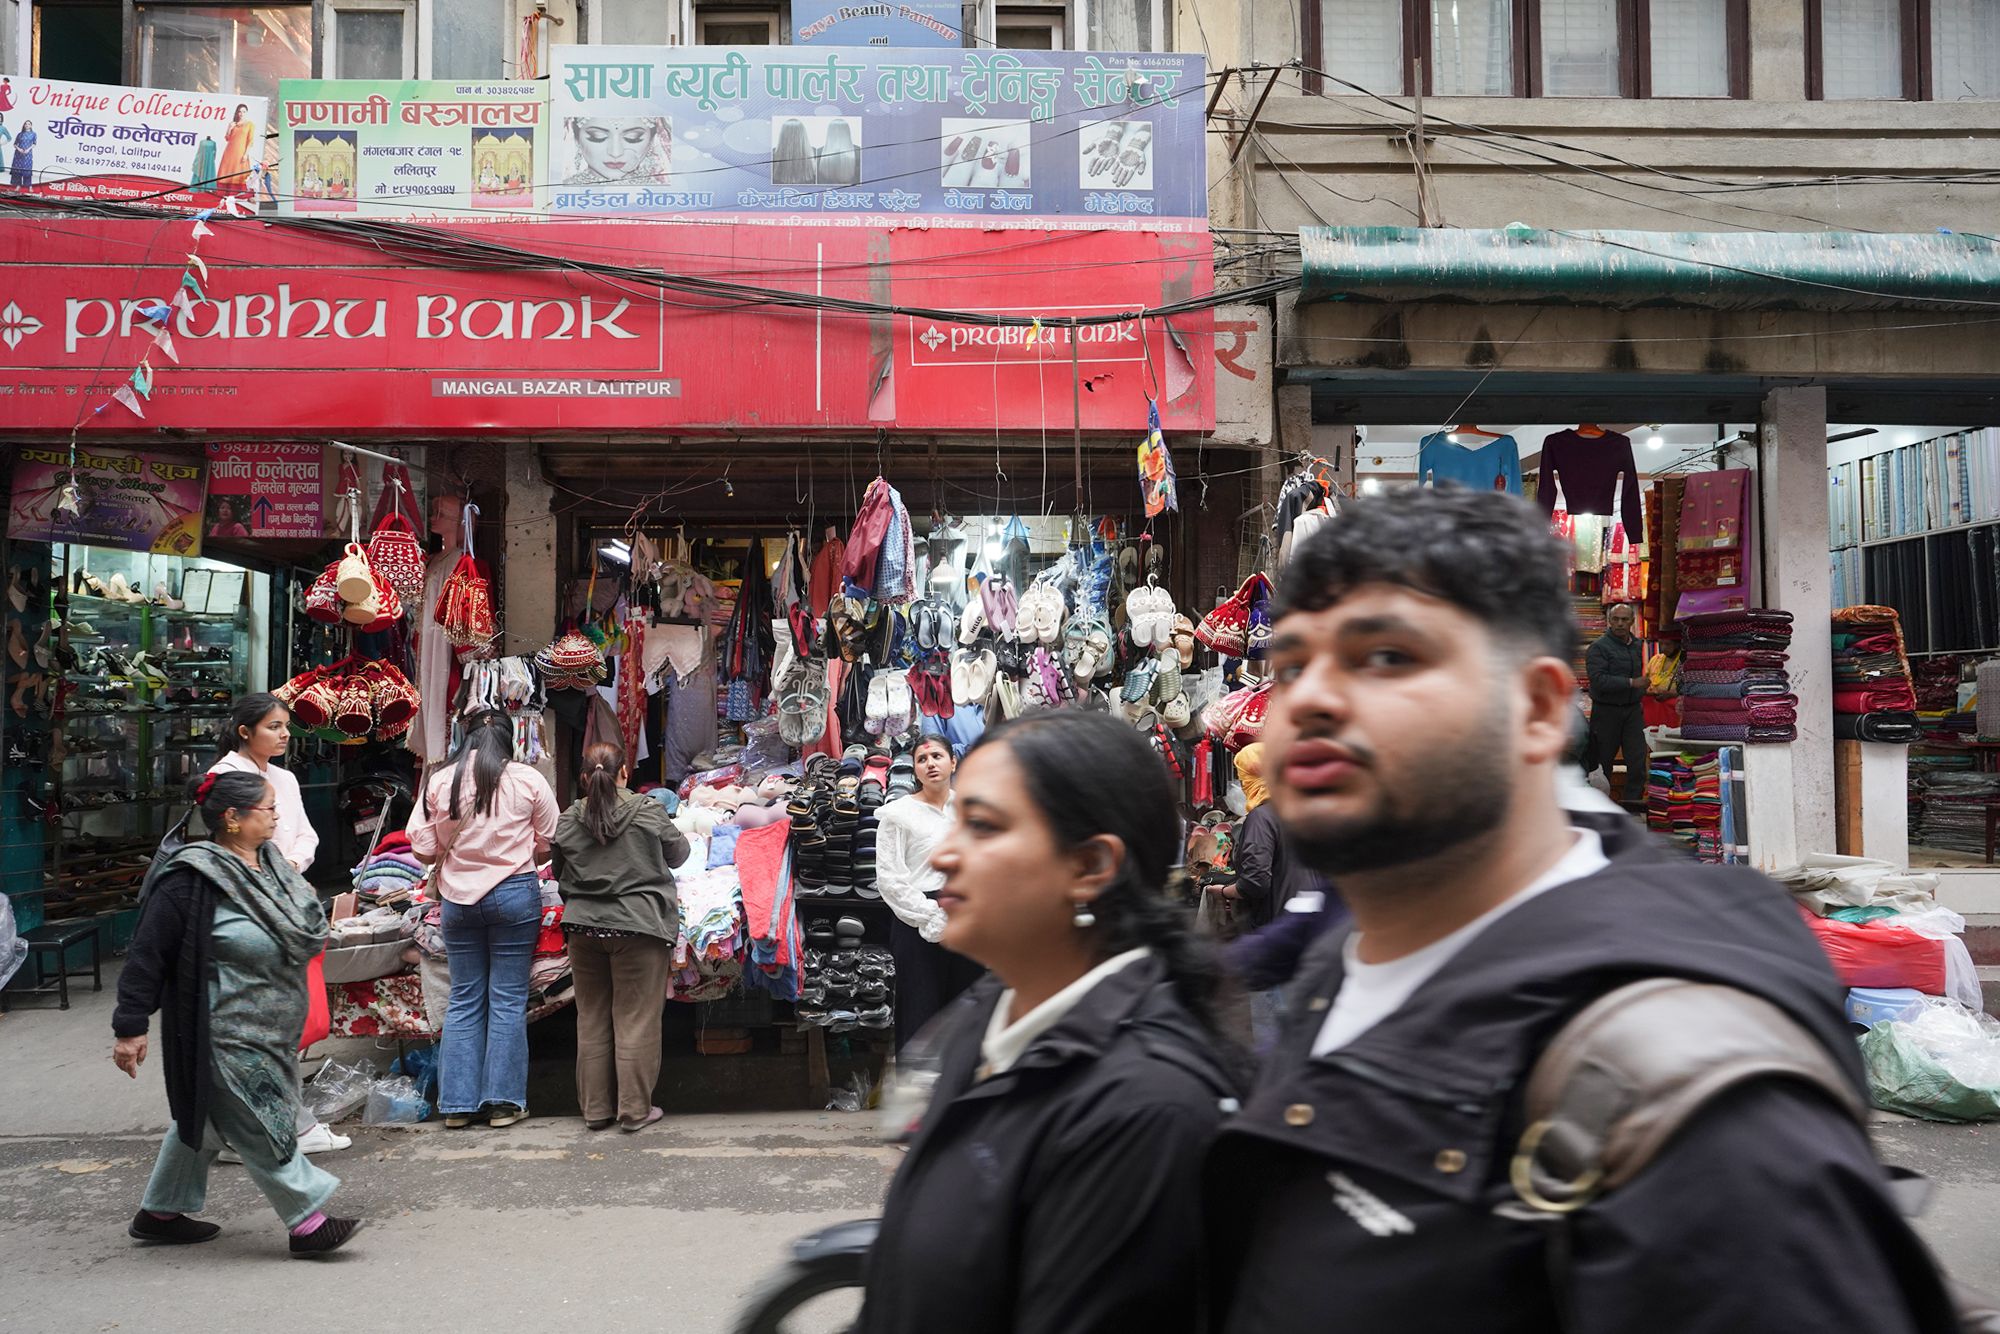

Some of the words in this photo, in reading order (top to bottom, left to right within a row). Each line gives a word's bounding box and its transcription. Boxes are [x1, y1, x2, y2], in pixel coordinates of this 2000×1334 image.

[799, 14, 837, 41] Saya
[839, 4, 894, 20] Beauty
[898, 5, 958, 40] Parlour
[869, 36, 888, 45] and
[1109, 57, 1124, 65] Pan
[1143, 58, 1184, 66] 616470581
[564, 63, 654, 101] साया
[763, 53, 868, 103] पार्लर
[877, 65, 951, 104] तथा
[29, 84, 110, 116] Unique
[117, 93, 226, 121] Collection
[286, 96, 390, 126] प्रणामी
[401, 101, 542, 126] बस्त्रालय
[48, 116, 107, 139] युनिक
[112, 123, 198, 146] कलेक्सन
[78, 142, 117, 156] Tangal,
[121, 146, 162, 159] Lalitpur
[131, 161, 182, 173] 9841494144
[394, 163, 437, 178] ललितपुर
[636, 188, 713, 207] मेकअप
[944, 189, 984, 210] नेल
[990, 189, 1033, 210] जेल
[442, 381, 517, 395] MANGAL
[522, 381, 582, 395] BAZAR
[587, 382, 671, 395] LALITPUR
[223, 443, 320, 455] 9841276798
[211, 455, 253, 479] शान्ति
[255, 456, 320, 480] कलेक्सन
[250, 479, 286, 495] होलसेल
